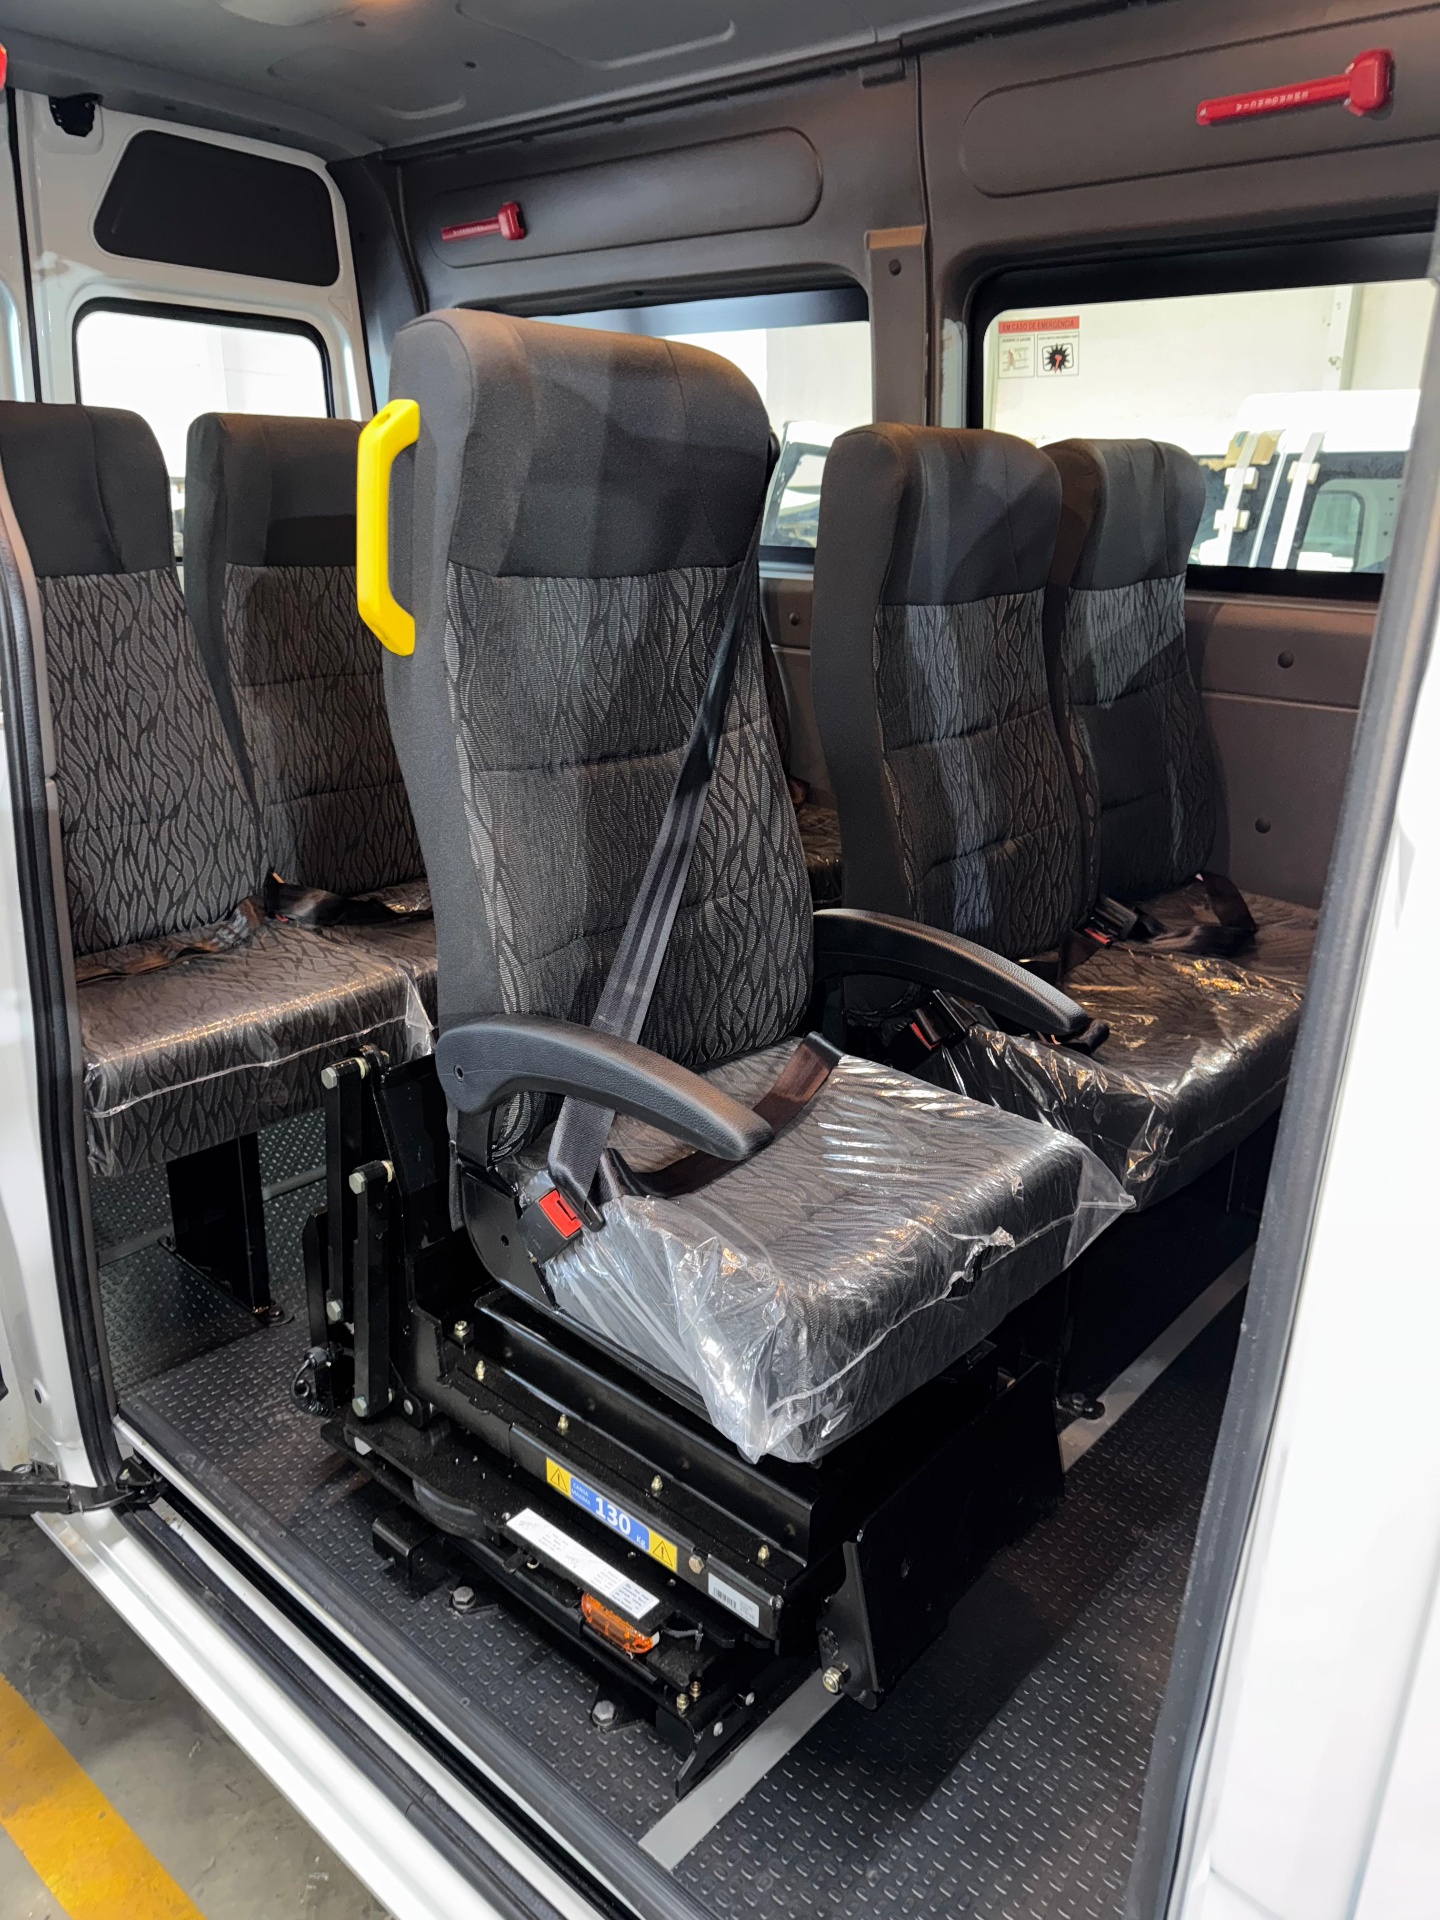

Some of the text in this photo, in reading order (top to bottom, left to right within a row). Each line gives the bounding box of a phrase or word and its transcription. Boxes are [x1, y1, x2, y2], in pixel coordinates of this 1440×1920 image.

[1012, 321, 1028, 331] CASO
[573, 1482, 589, 1497] CARGA
[595, 1497, 631, 1535] 130
